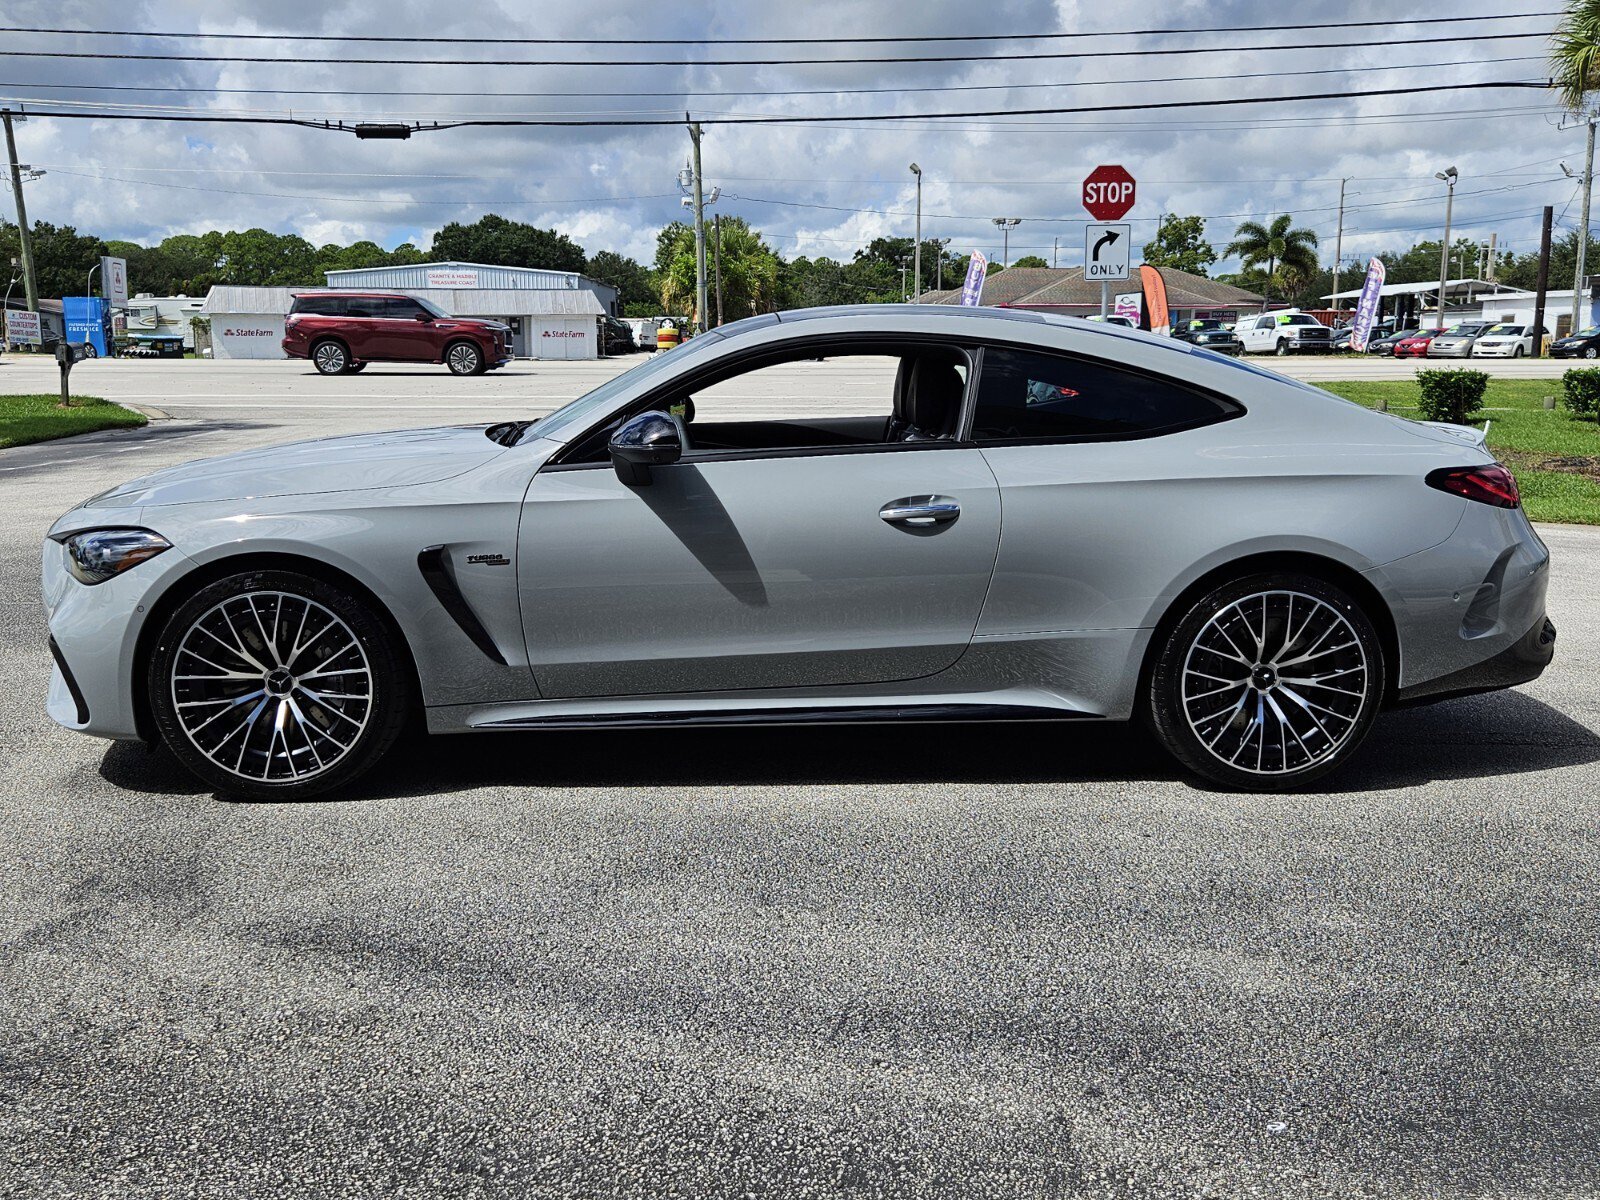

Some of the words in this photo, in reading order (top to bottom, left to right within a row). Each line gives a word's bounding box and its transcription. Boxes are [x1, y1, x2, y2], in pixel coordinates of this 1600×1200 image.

[1085, 182, 1133, 204] STOP
[1090, 264, 1124, 275] ONLY
[18, 312, 38, 321] CUSTOM
[9, 321, 38, 330] COUNTERTOPS
